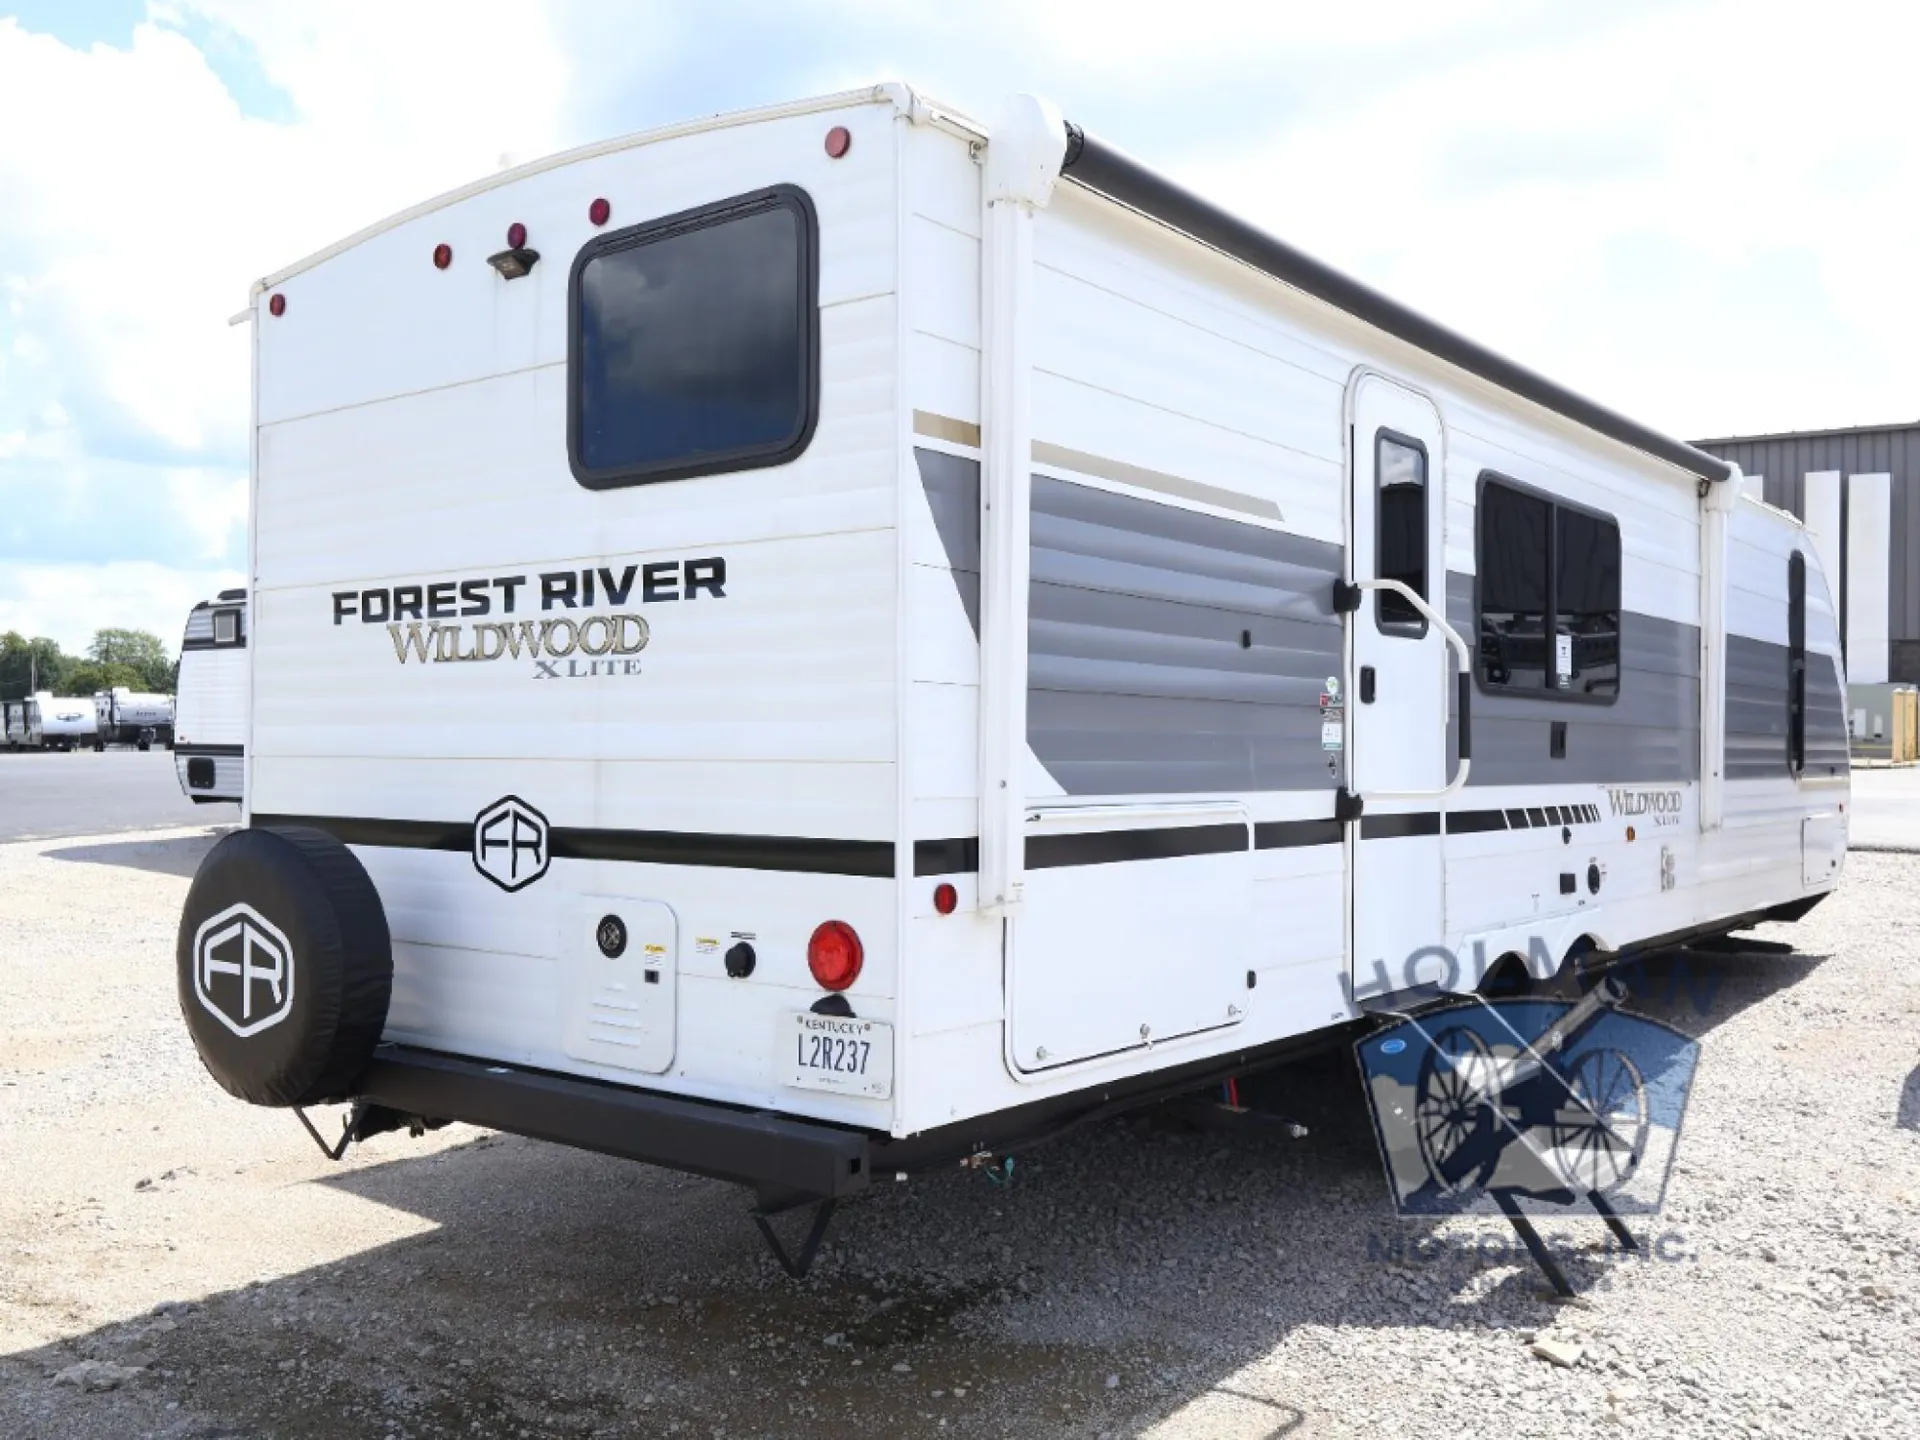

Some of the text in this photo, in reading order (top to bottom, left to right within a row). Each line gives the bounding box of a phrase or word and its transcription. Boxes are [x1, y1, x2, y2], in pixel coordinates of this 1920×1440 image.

[332, 556, 727, 625] FOREST RIVER
[386, 613, 650, 664] WILDWOOD
[1607, 788, 1683, 817] WILDWOOD
[805, 1018, 864, 1036] KENTUCKY
[798, 1032, 871, 1075] L2R237
